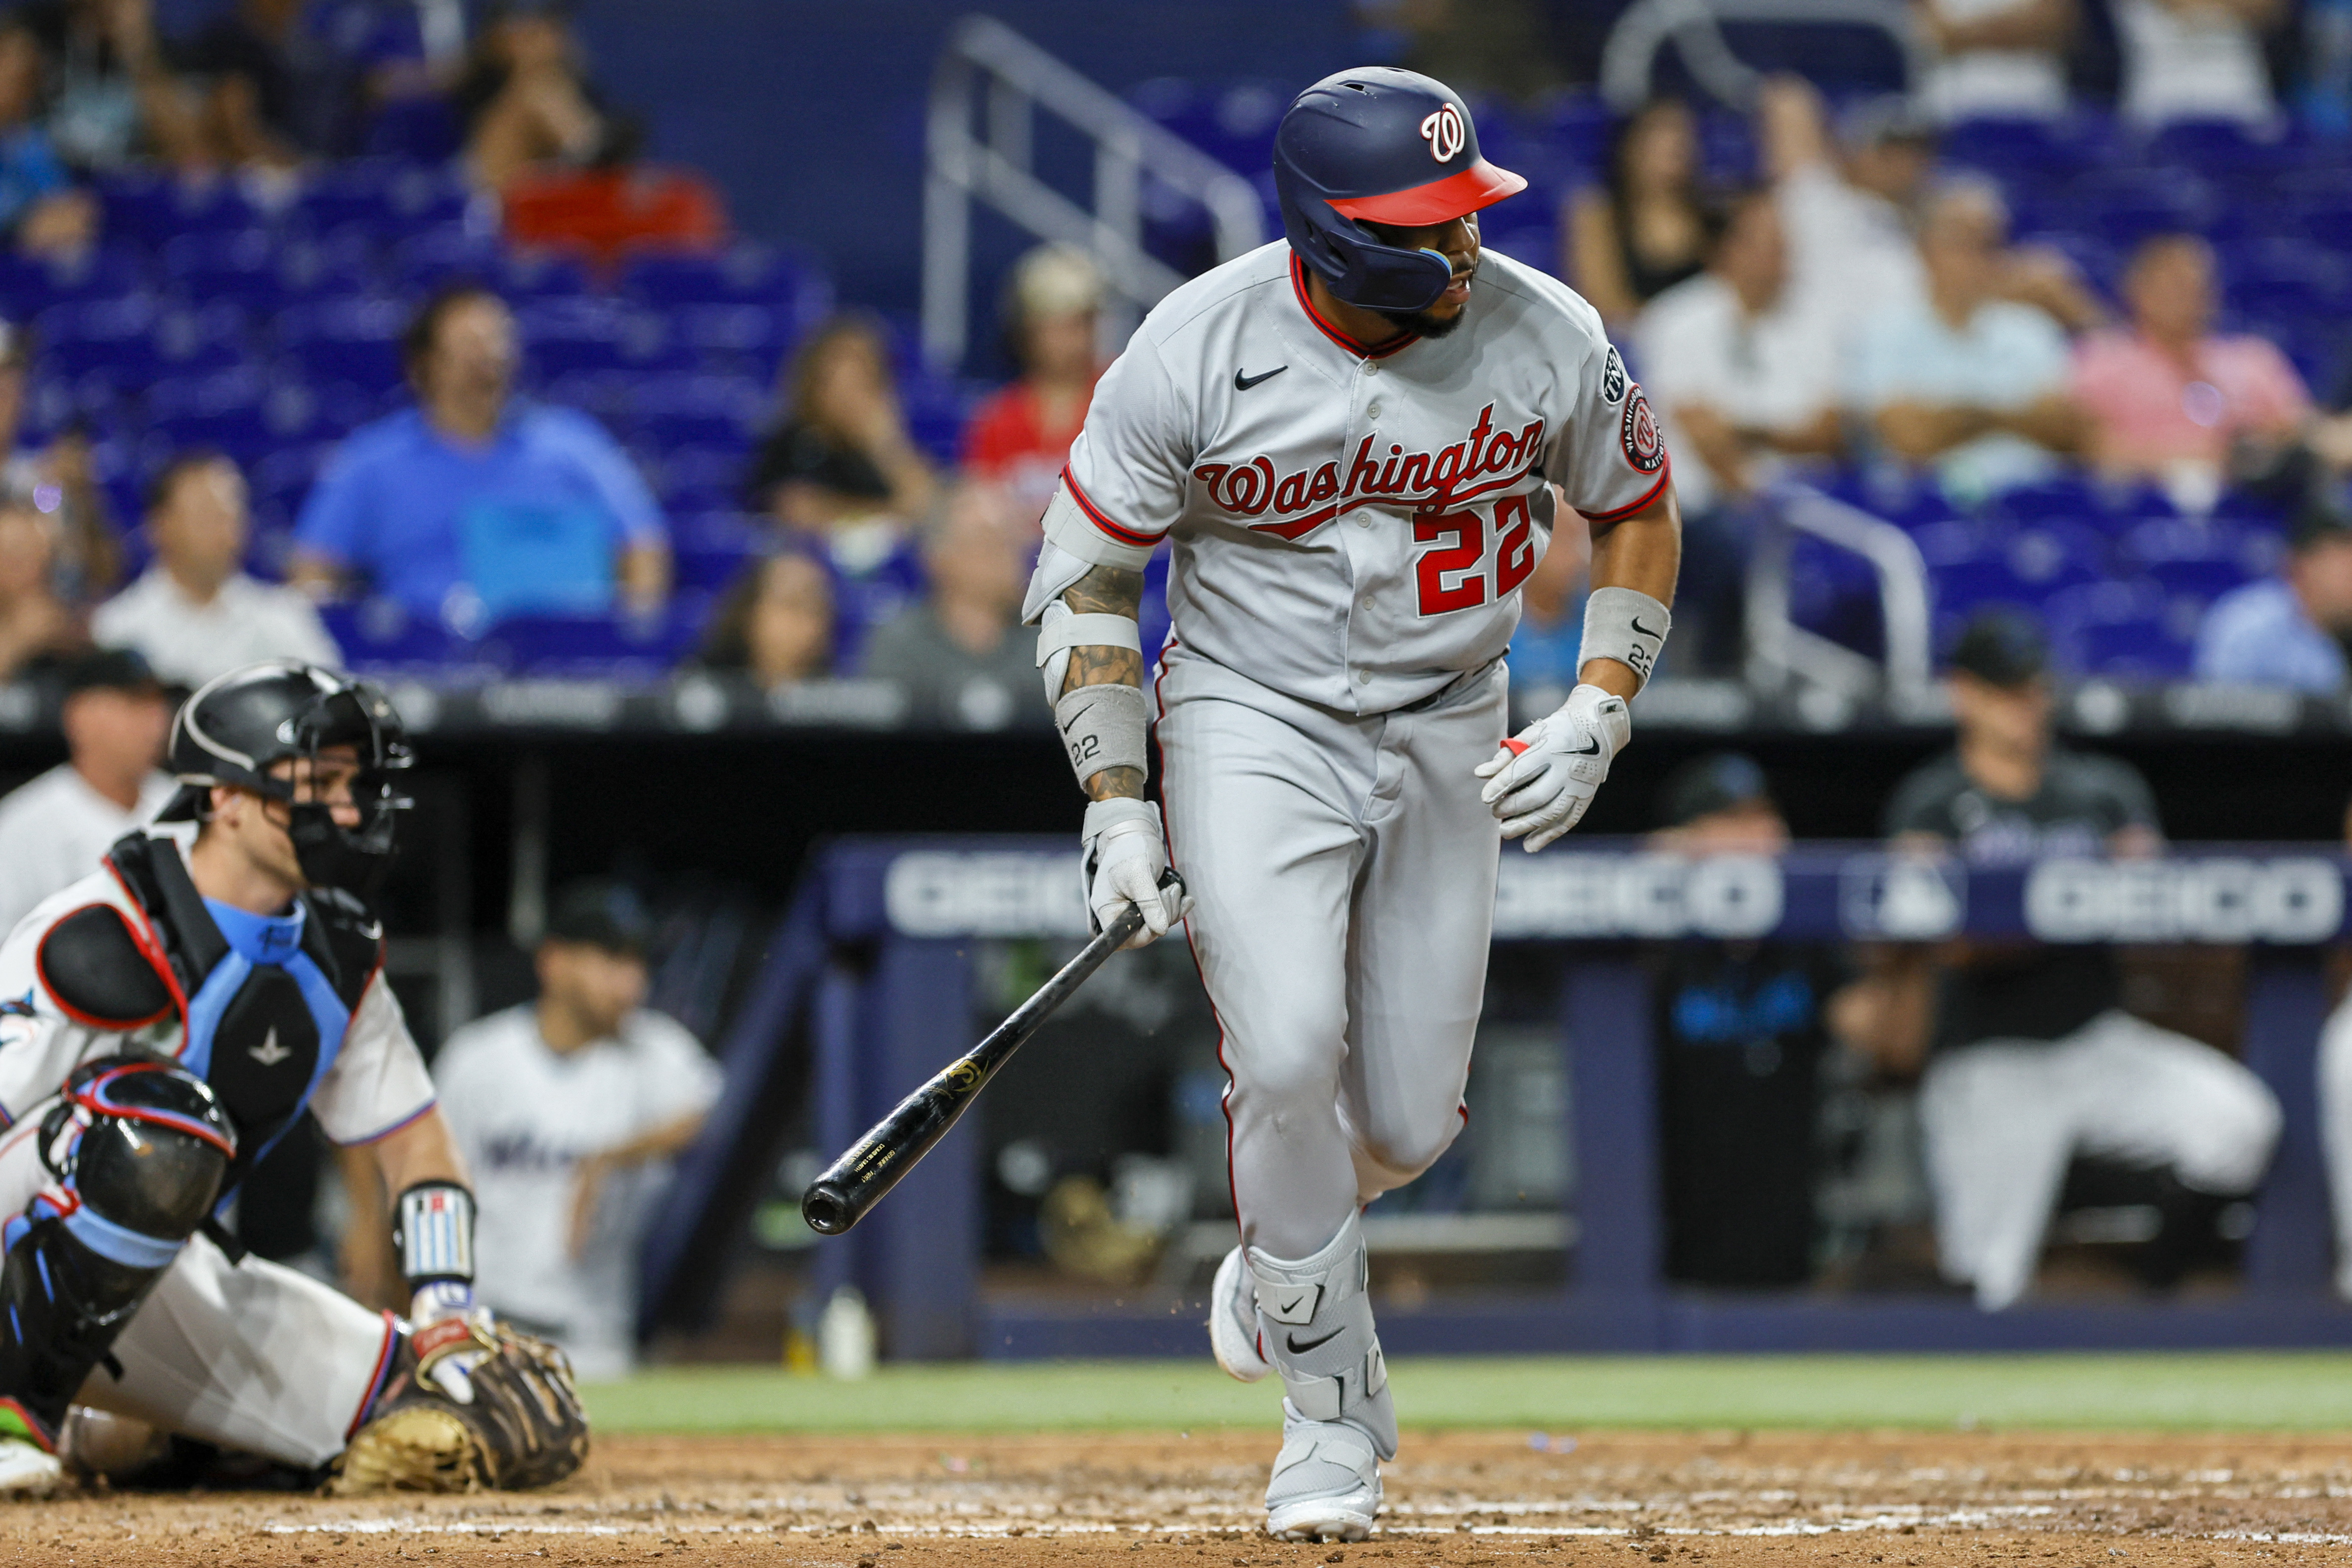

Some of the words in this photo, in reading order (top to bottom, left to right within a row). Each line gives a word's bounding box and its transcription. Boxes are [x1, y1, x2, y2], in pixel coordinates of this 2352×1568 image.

[1420, 102, 1465, 164] W
[1191, 399, 1544, 515] Washington
[1411, 495, 1536, 619] 22
[1071, 734, 1101, 767] 22
[854, 1159, 869, 1172] SMITH
[866, 1143, 885, 1160] DOMINIC
